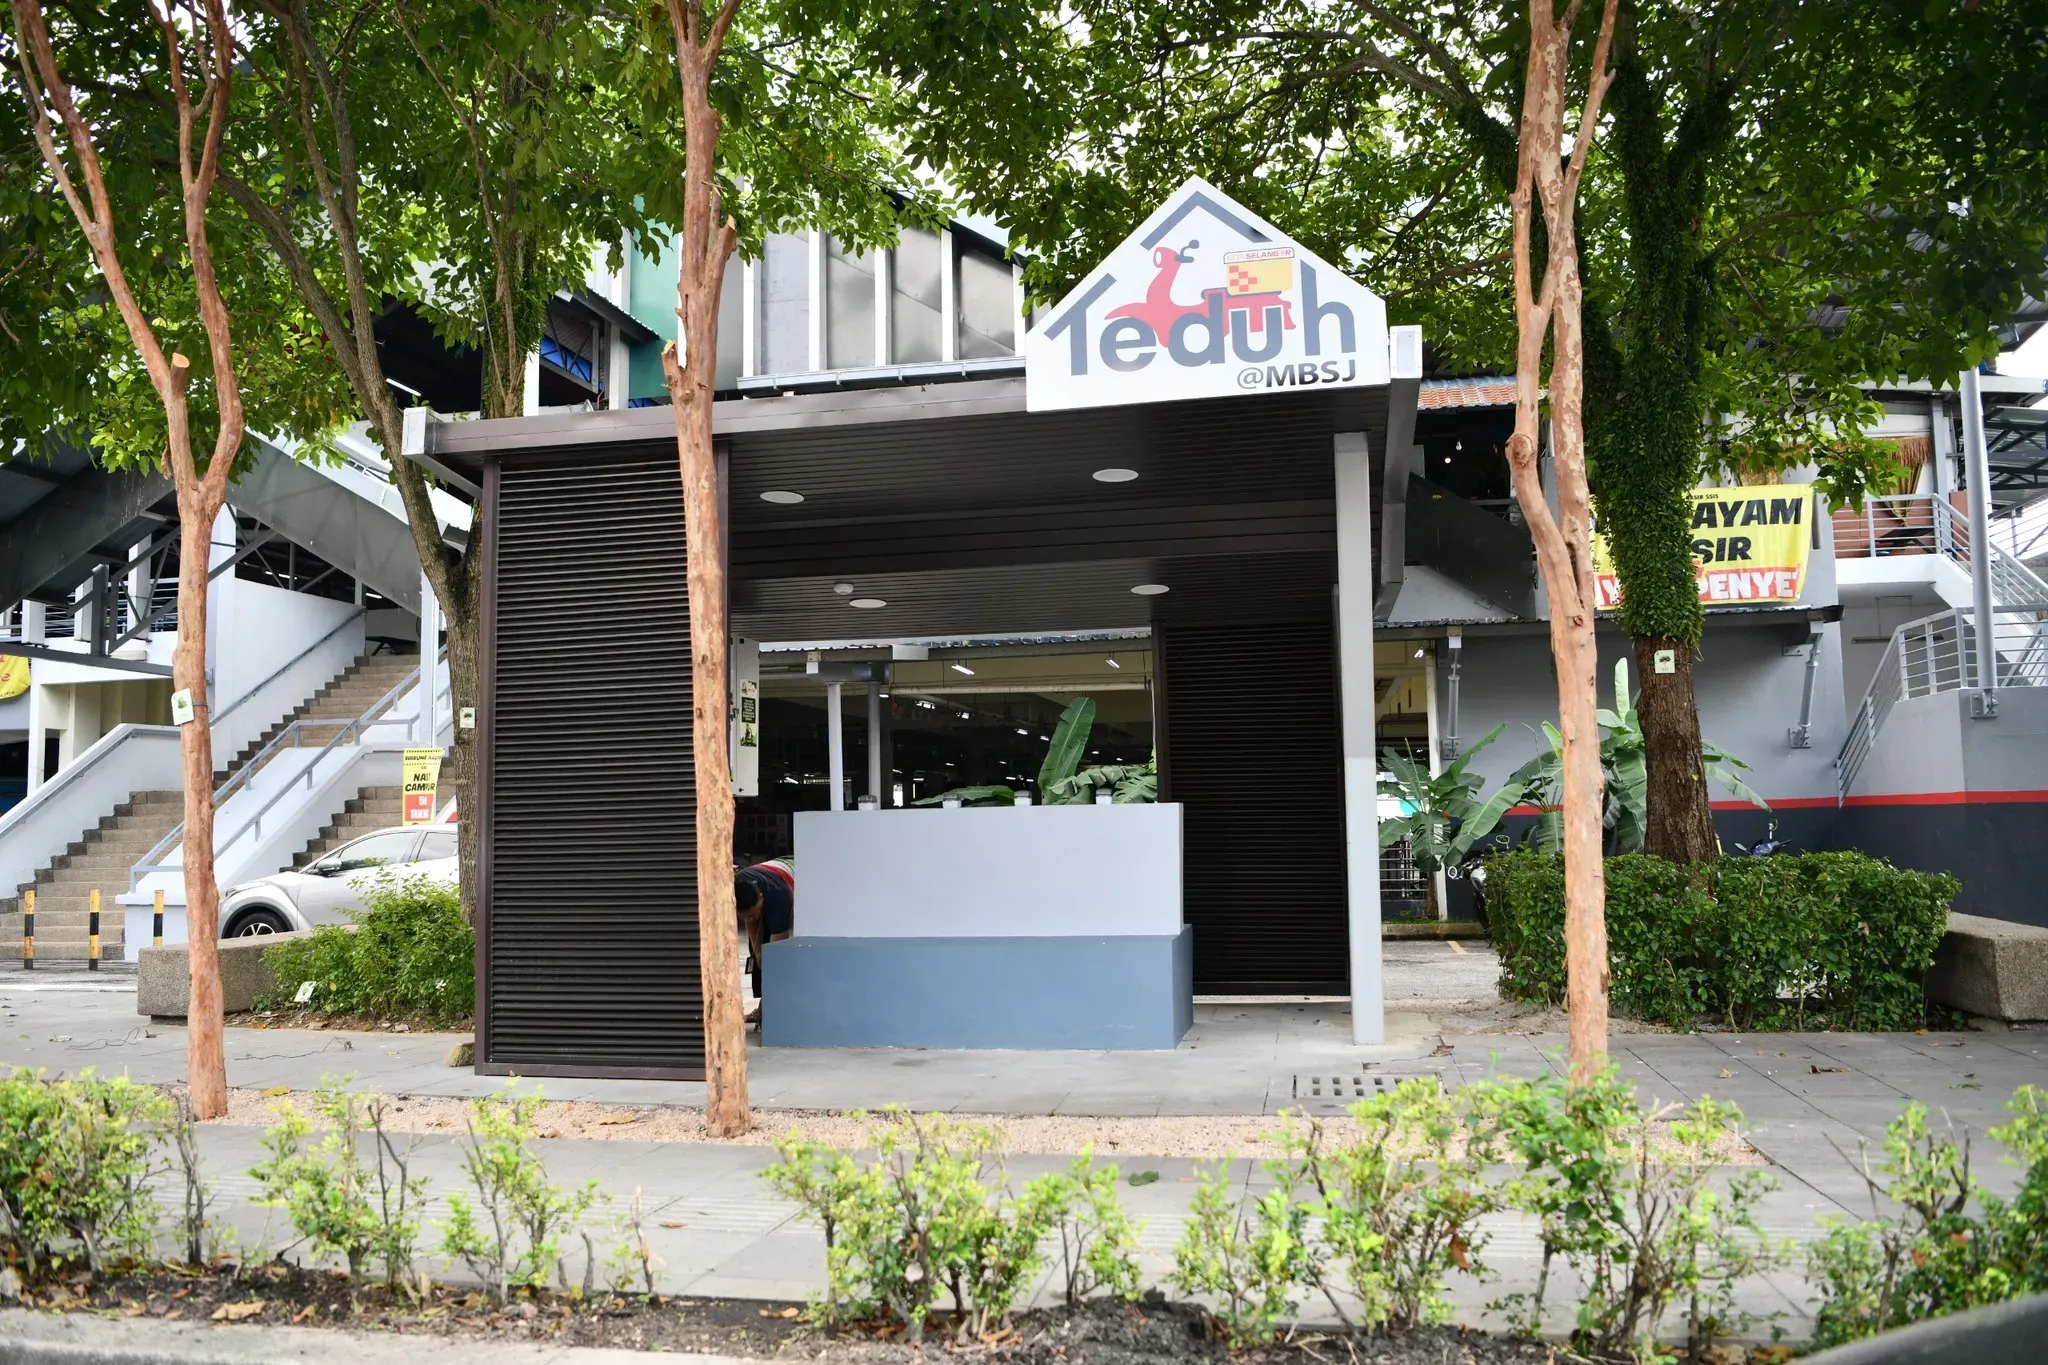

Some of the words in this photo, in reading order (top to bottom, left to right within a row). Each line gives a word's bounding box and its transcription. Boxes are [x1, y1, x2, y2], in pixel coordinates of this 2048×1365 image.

[1044, 260, 1357, 376] Teduh
[1237, 359, 1356, 389] @MBSJ
[1690, 497, 1803, 529] AYAM
[1690, 536, 1752, 565] SIR
[1697, 570, 1798, 600] PENYE
